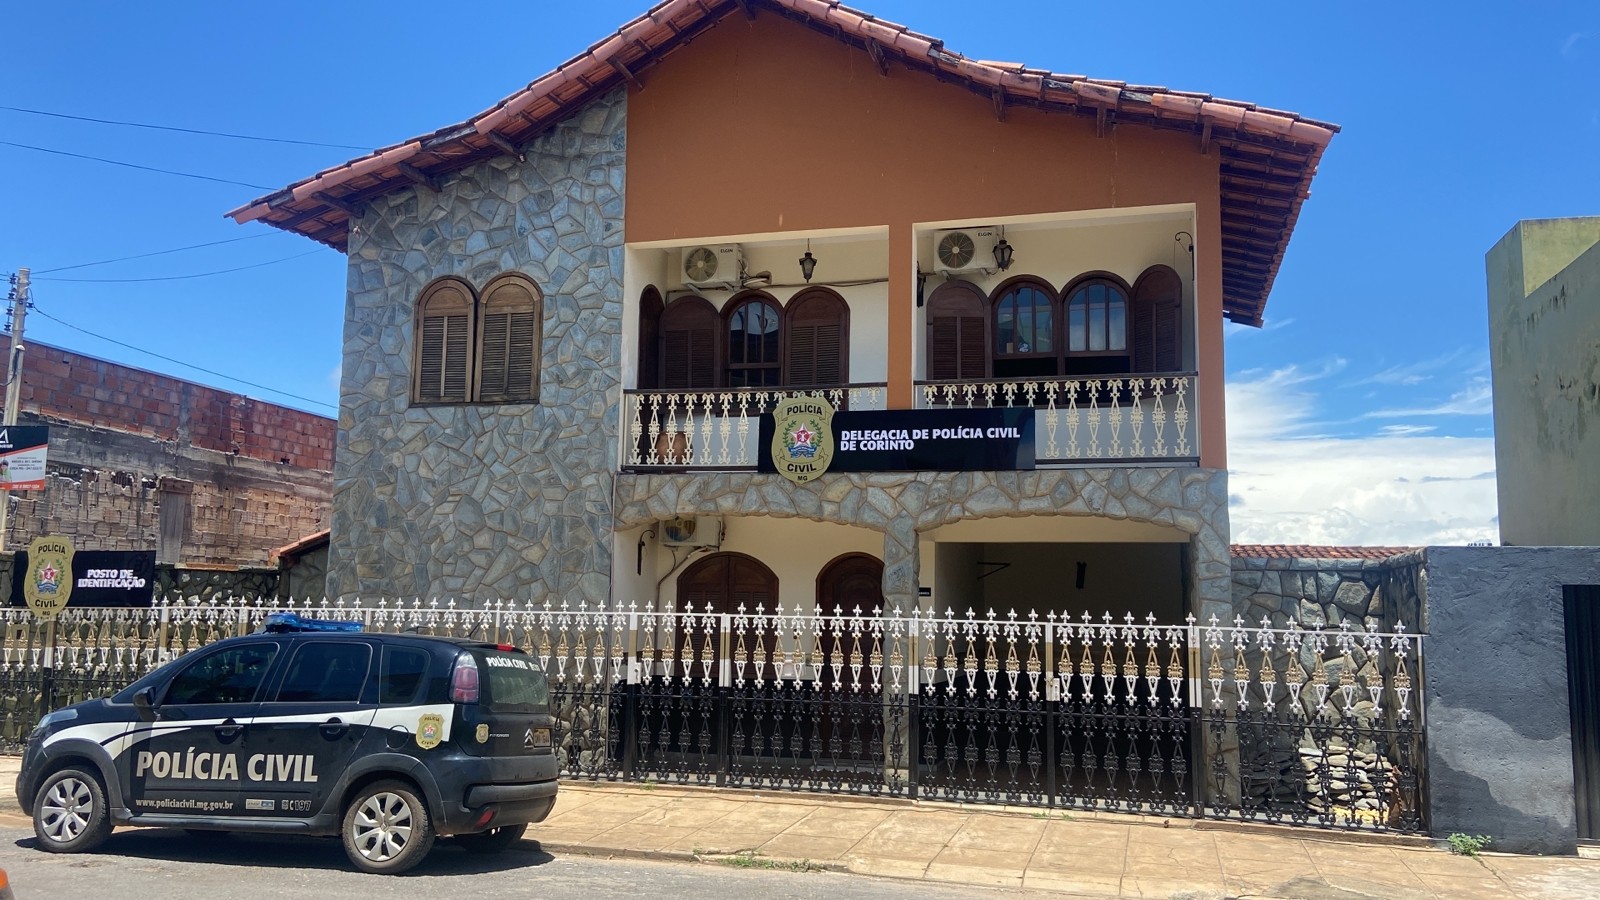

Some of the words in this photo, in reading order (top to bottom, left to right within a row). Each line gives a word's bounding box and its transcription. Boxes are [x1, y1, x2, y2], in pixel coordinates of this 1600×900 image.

[786, 402, 823, 416] POLÍCIA
[841, 429, 910, 441] DELEGACIA
[912, 429, 929, 440] DE
[932, 425, 984, 440] POLÍCIA
[987, 427, 1021, 439] CIVIL
[840, 440, 857, 451] DE
[859, 439, 915, 451] CORINTO
[787, 463, 817, 474] CIVIL
[38, 542, 66, 554] POLÍCIA
[87, 569, 118, 579] POSTO
[119, 569, 134, 579] DE
[77, 576, 146, 590] IDENTIFICAÇÃO
[34, 599, 58, 608] CIVIL
[485, 655, 513, 667] POLÍCIA
[512, 658, 528, 670] CIVIL
[136, 746, 239, 781] POLÍCIA
[247, 753, 318, 783] CIVIL
[135, 799, 234, 811] www.policiacivil.mg.gov.br
[294, 800, 312, 812] 197
